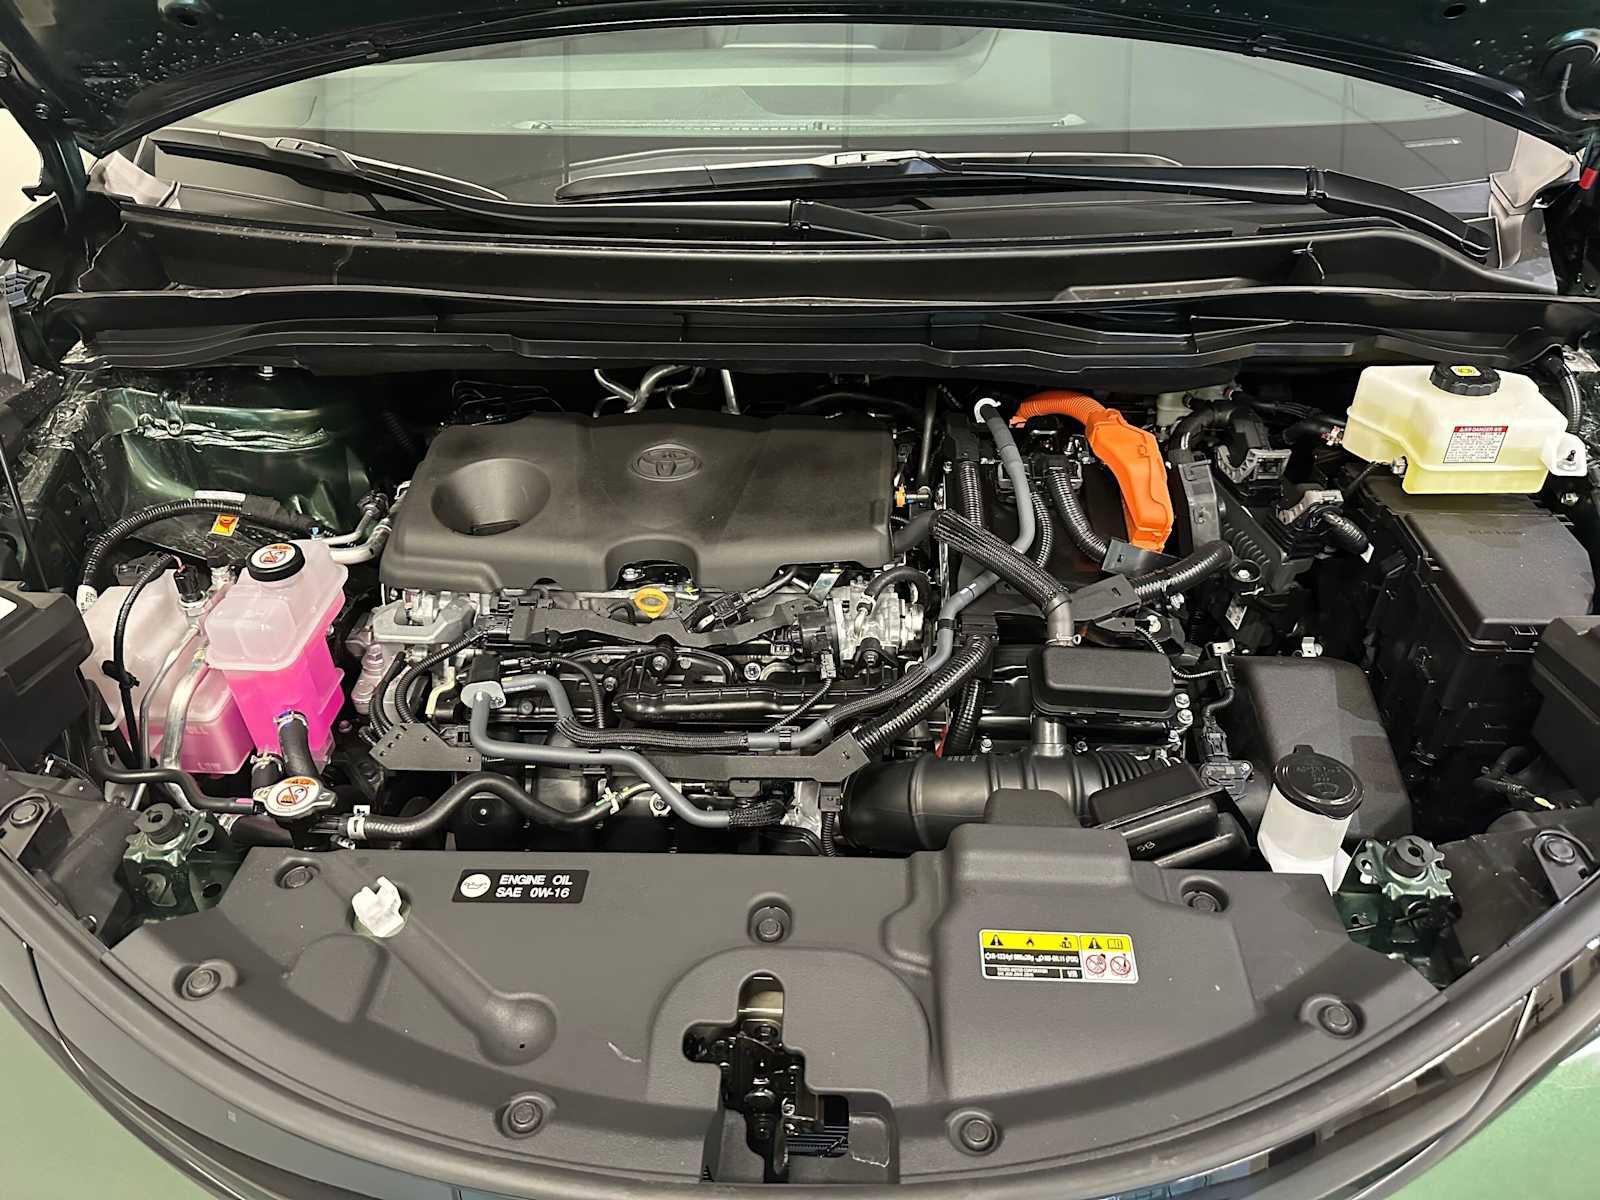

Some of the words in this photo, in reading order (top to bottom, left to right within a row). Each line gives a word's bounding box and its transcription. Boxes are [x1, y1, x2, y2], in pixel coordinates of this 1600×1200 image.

[499, 874, 547, 885] ENGINE
[552, 874, 573, 886] OIL
[495, 887, 523, 898] SAE
[529, 887, 570, 898] 0W-16
